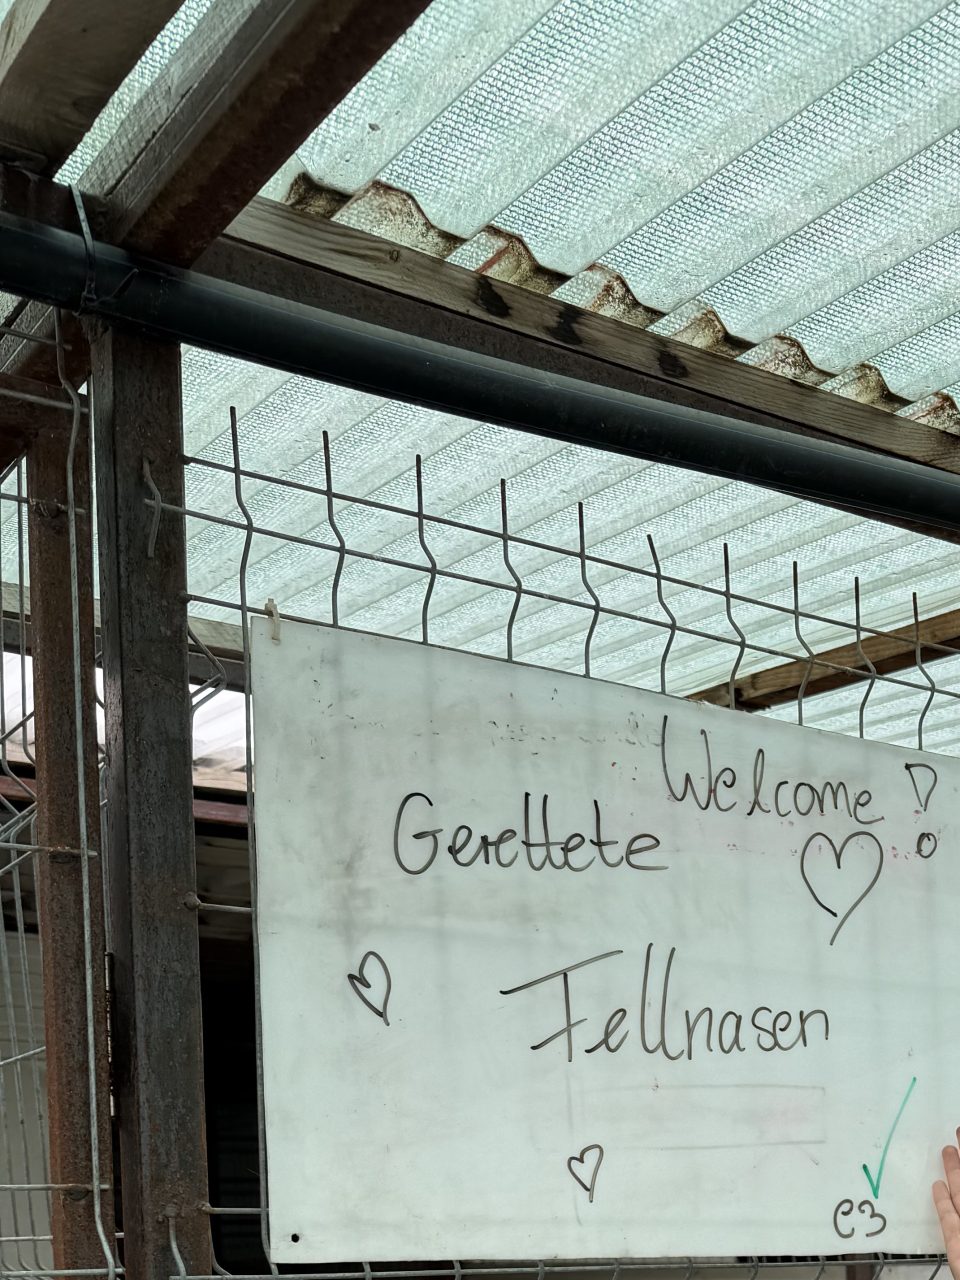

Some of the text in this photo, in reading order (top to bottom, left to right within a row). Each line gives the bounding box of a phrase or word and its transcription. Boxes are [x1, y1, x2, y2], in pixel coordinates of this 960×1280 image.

[661, 714, 884, 825] Welcome
[392, 791, 669, 875] Gerettete
[499, 942, 831, 1062] Fellnasen
